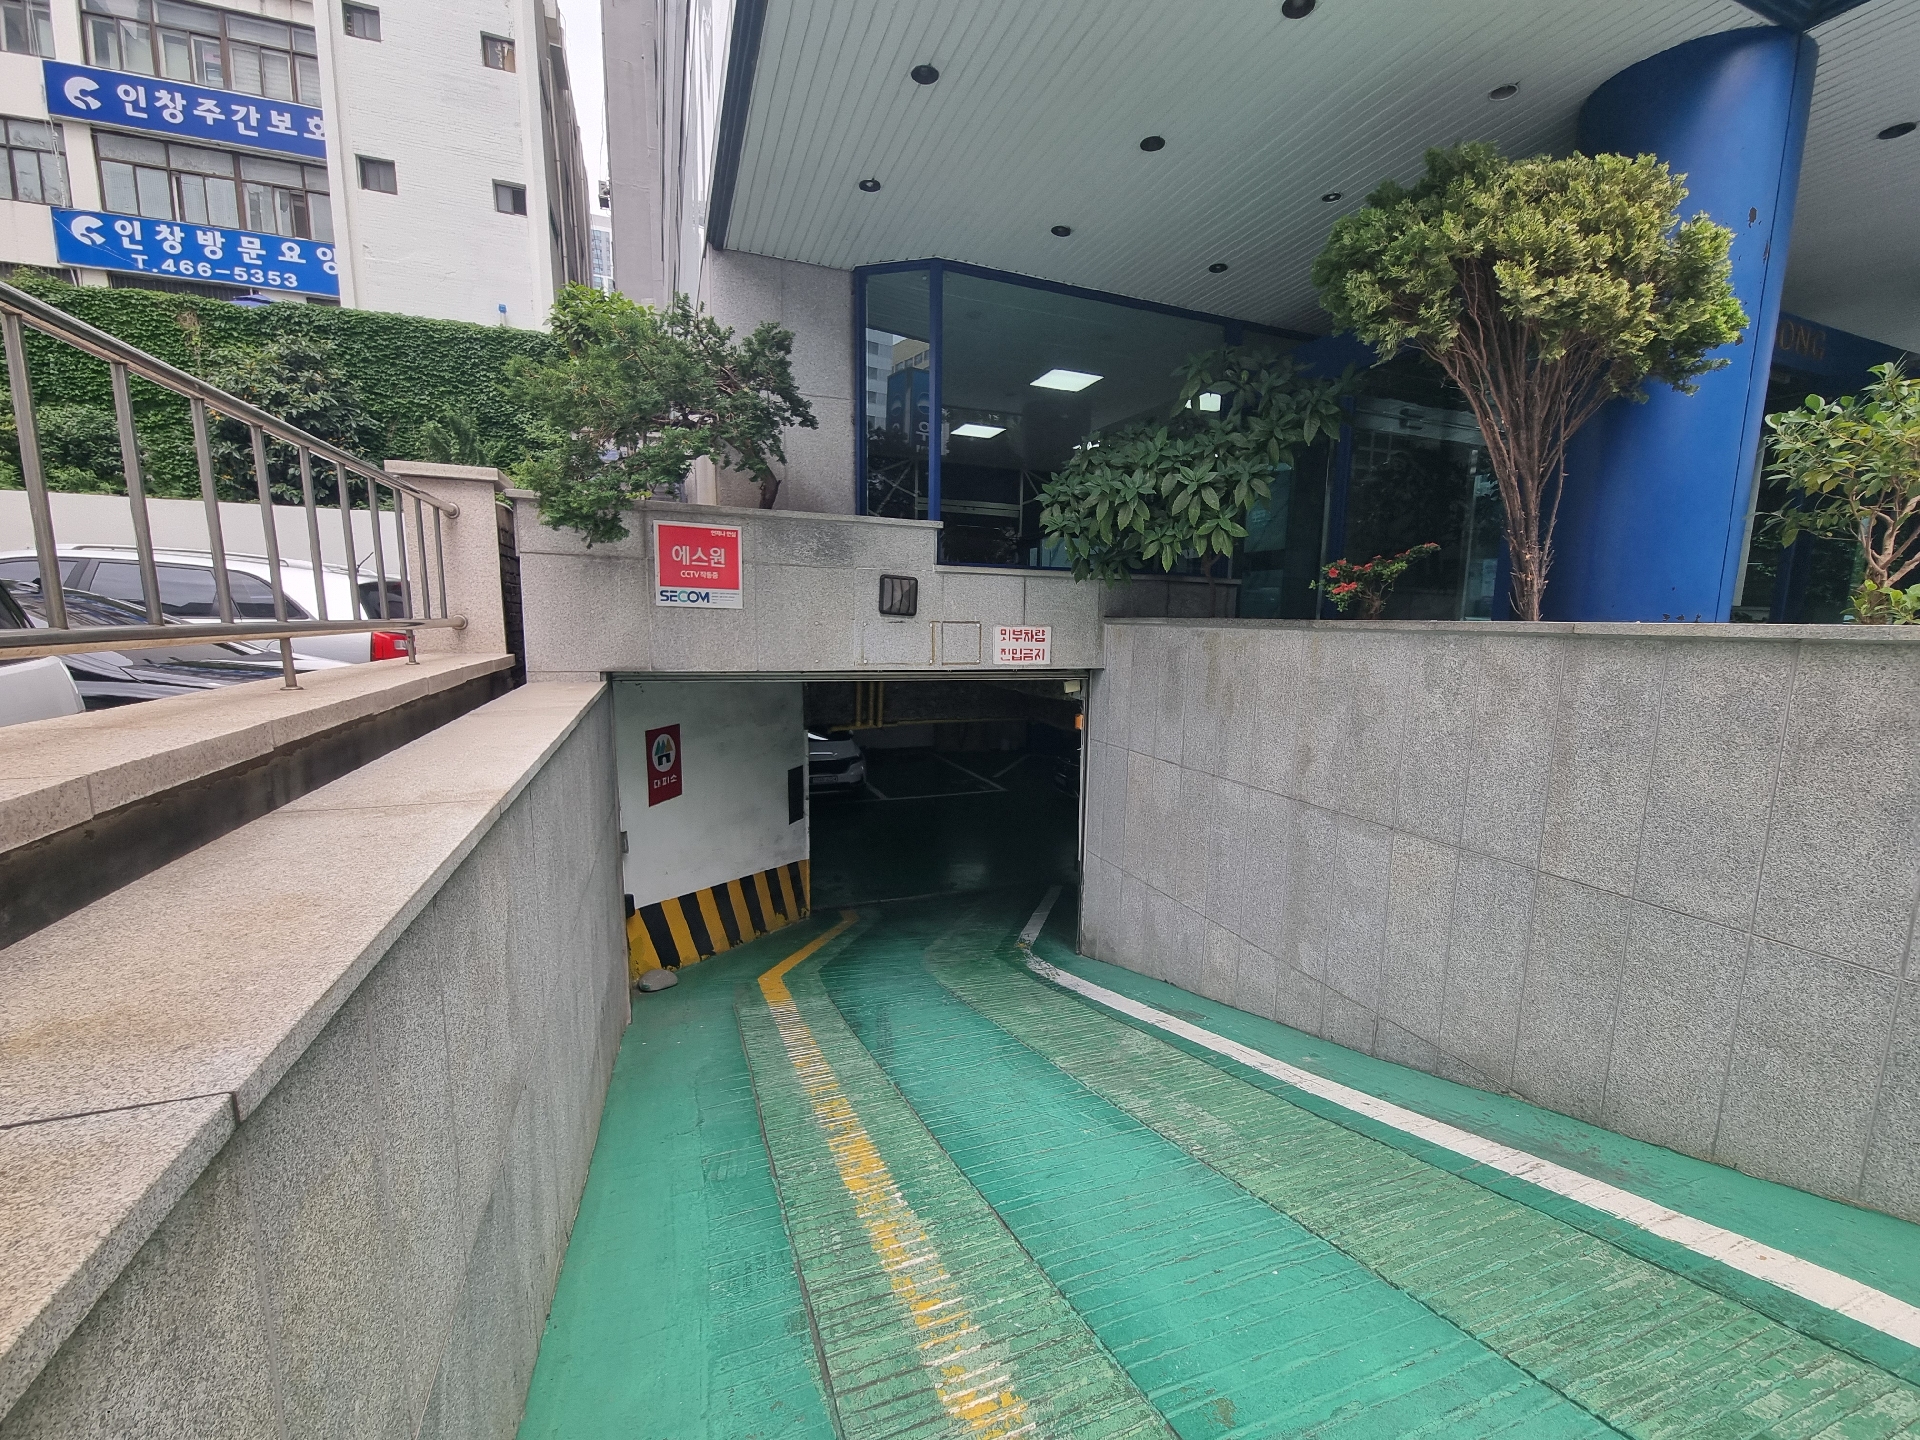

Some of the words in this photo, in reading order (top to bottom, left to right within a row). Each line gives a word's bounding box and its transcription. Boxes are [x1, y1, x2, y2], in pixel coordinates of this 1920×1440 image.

[671, 545, 726, 568] 에스원
[680, 570, 700, 578] CCTV
[659, 590, 710, 603] SECOM
[1000, 648, 1046, 661] 진입금지
[653, 774, 678, 789] 대피소
